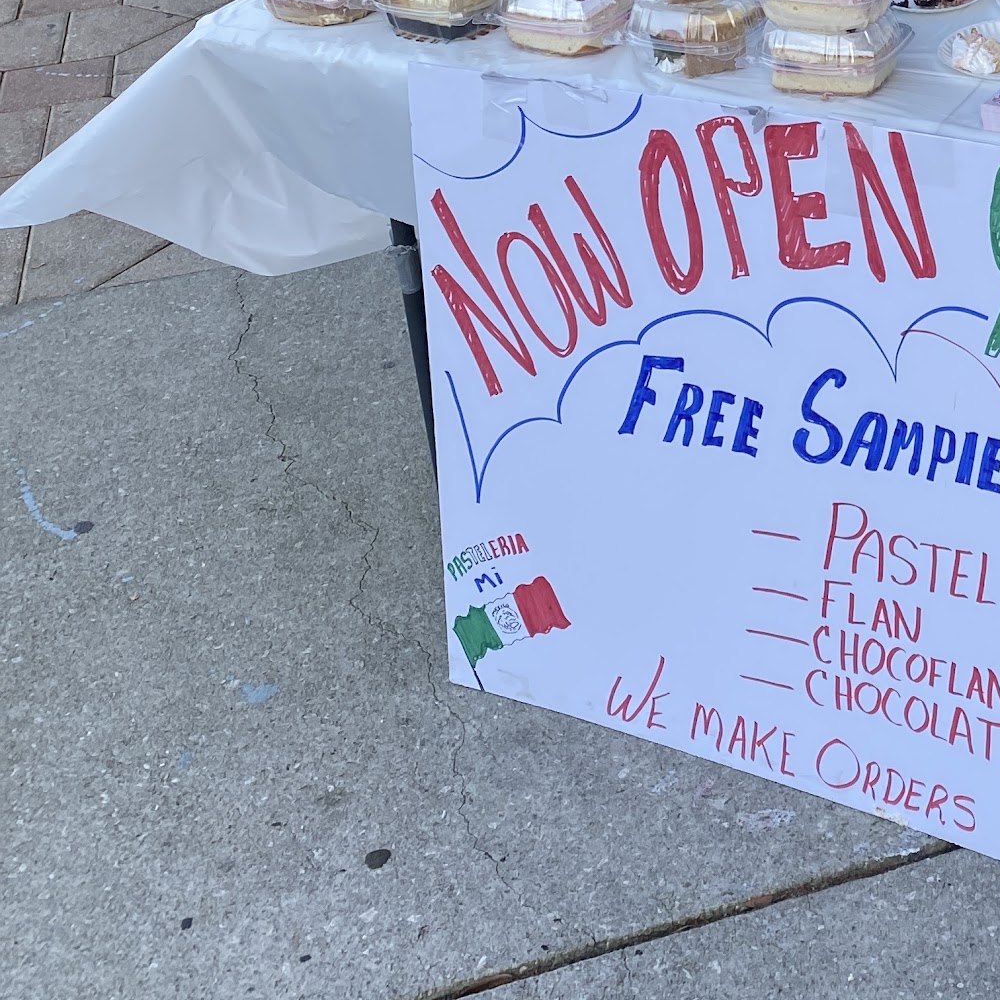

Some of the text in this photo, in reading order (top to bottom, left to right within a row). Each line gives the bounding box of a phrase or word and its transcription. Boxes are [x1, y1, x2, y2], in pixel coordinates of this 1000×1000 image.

[430, 175, 633, 397] NOW
[638, 116, 937, 295] OPEN
[618, 354, 765, 458] FREE
[446, 533, 530, 582] PASTELERIA
[823, 502, 997, 604] PASTEL
[820, 580, 922, 643] FLAN
[606, 655, 976, 832] WE MAKE ORDERS
